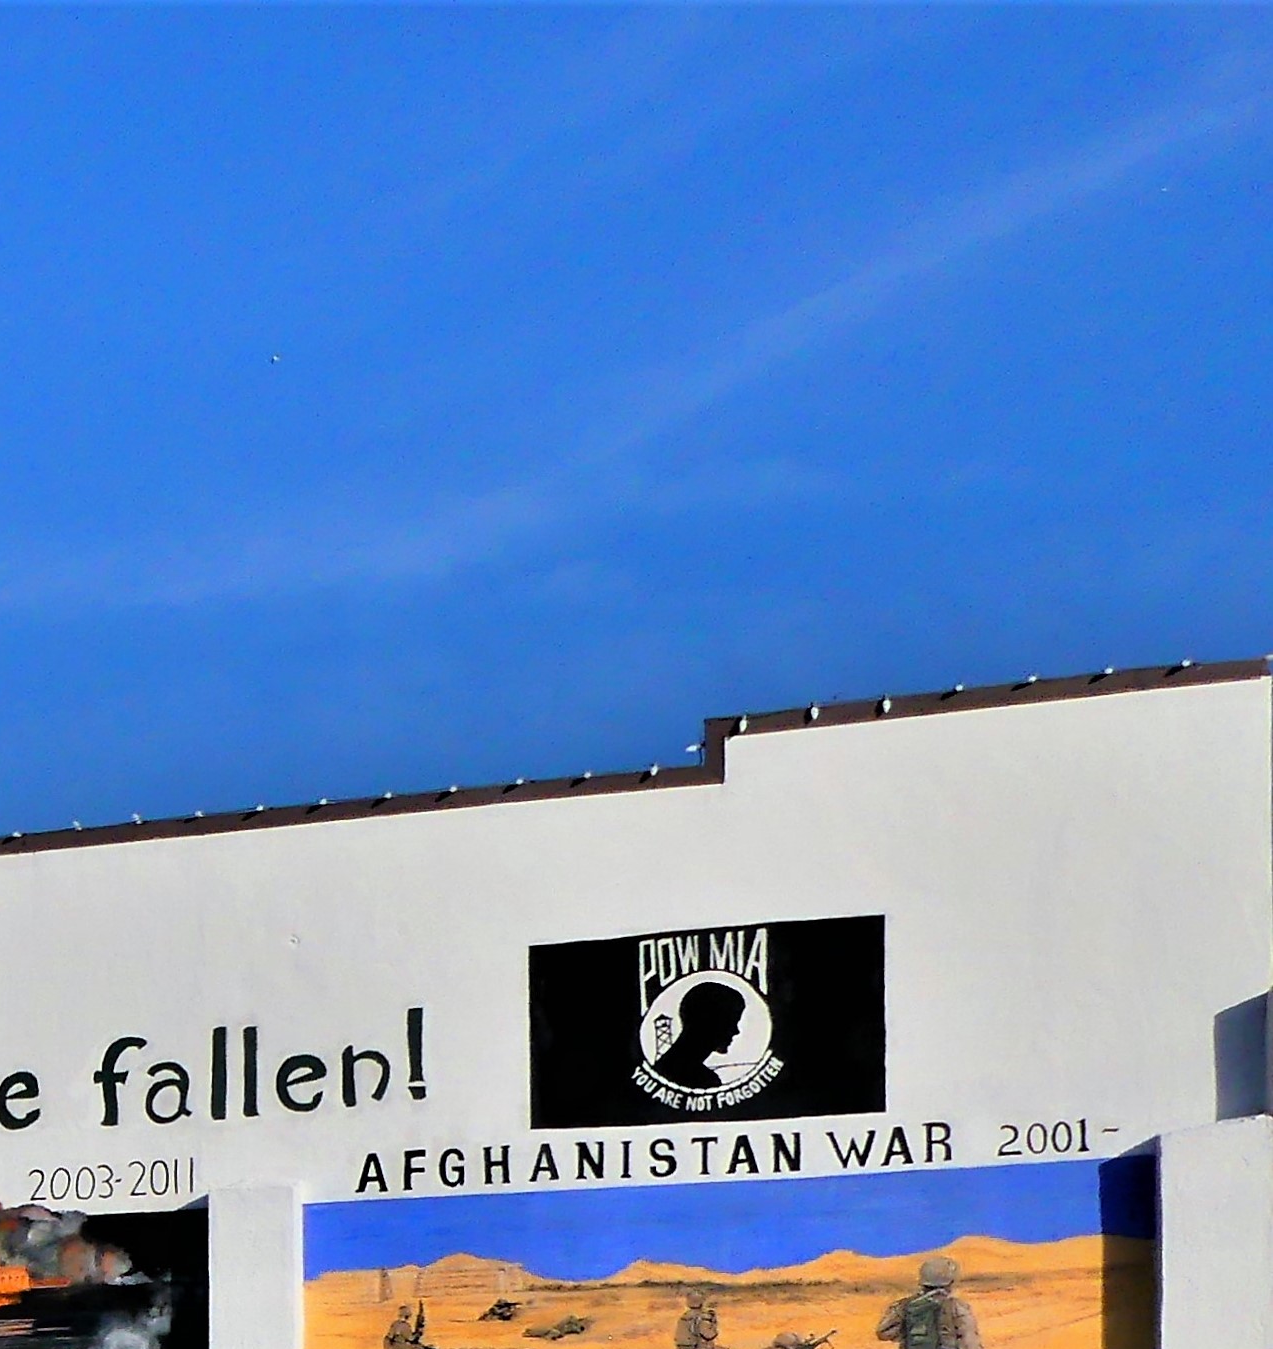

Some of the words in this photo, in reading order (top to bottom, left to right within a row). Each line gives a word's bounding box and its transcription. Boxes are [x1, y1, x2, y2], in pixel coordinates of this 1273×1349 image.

[638, 935, 700, 1017] POW
[709, 928, 769, 996] MIA
[93, 1006, 427, 1127] fallen!
[631, 1066, 657, 1094] YOU
[652, 1086, 684, 1109] ARE
[685, 1094, 714, 1112] NOT
[716, 1056, 786, 1109] FORGOTTEN
[28, 1156, 195, 1202] 2003-2011
[354, 1131, 803, 1194] AFGHANISTAN
[824, 1122, 953, 1169] WAR
